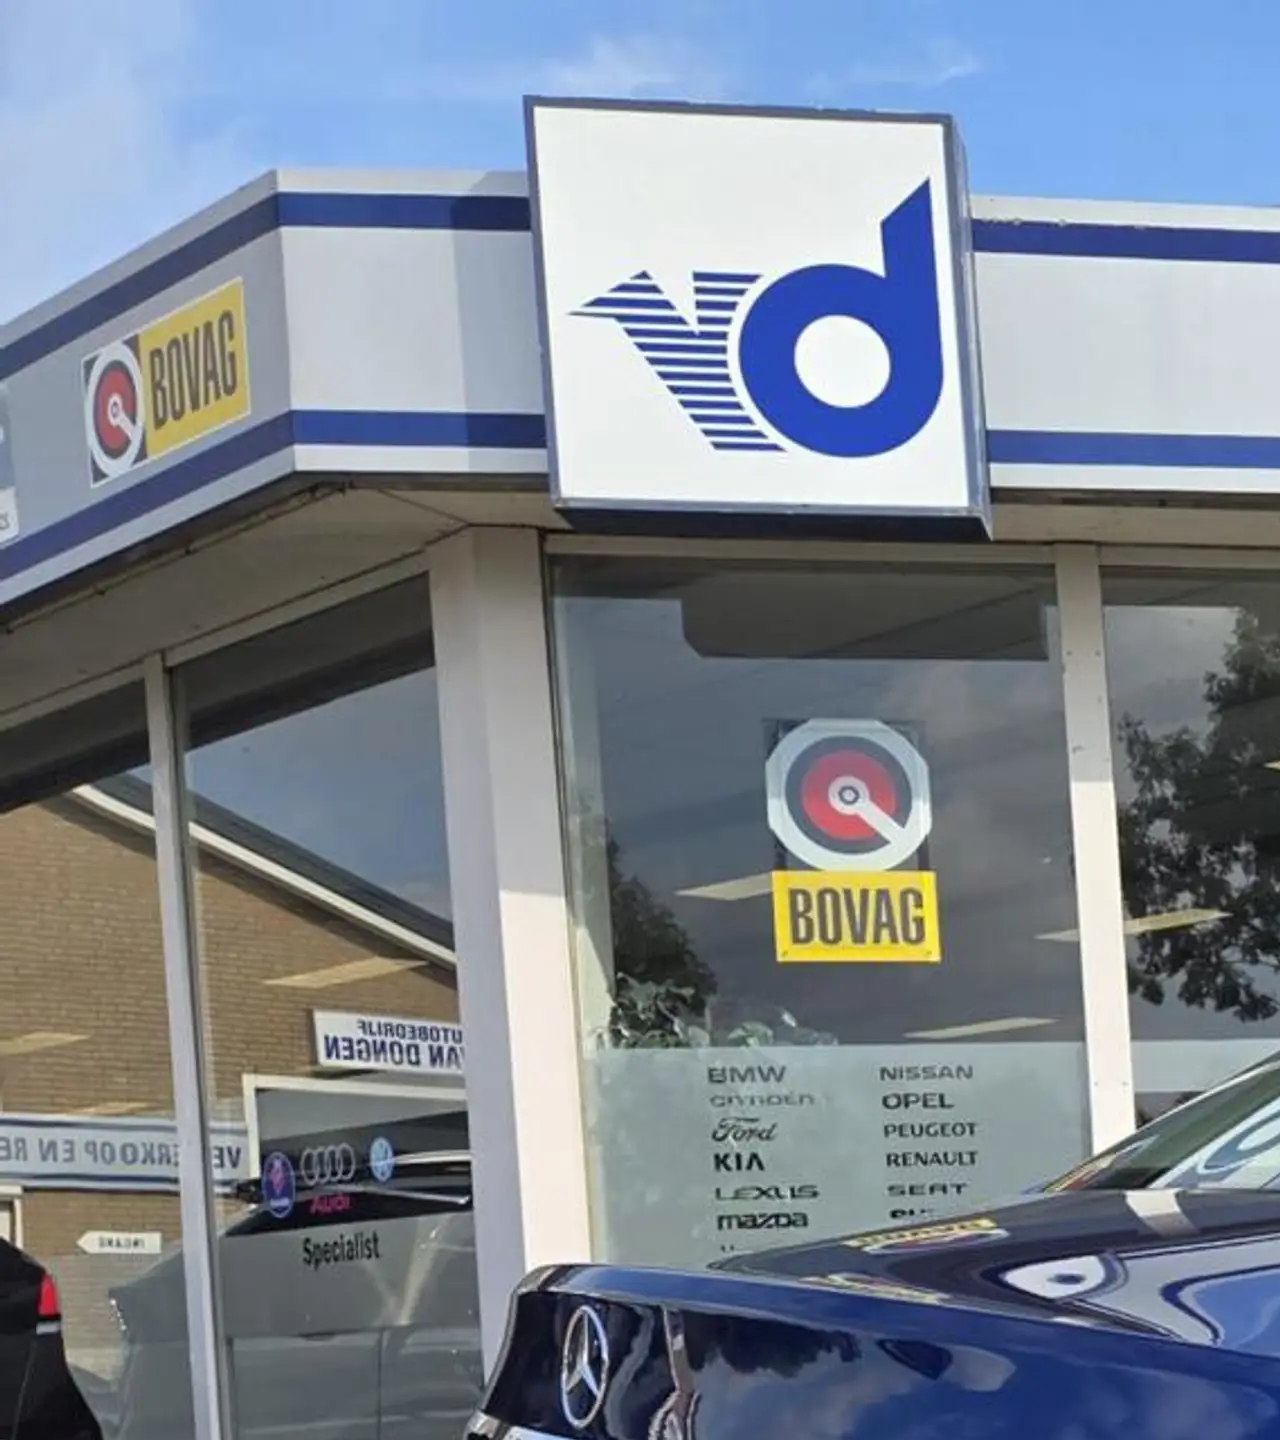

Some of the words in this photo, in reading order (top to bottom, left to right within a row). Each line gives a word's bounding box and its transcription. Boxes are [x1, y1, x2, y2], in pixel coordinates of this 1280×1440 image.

[149, 309, 238, 431] BOVAG
[788, 887, 926, 946] BOVAG
[707, 1065, 787, 1084] BMW
[879, 1065, 974, 1081] NISSAN
[881, 1093, 955, 1110] OPEL
[711, 1117, 778, 1142] Ford
[883, 1122, 978, 1138] PEUGEOT
[714, 1152, 765, 1172] KIA
[885, 1151, 979, 1167] RENAULT
[715, 1185, 820, 1201] LEXUS
[888, 1182, 968, 1197] SEAT
[302, 1231, 381, 1272] Specialist
